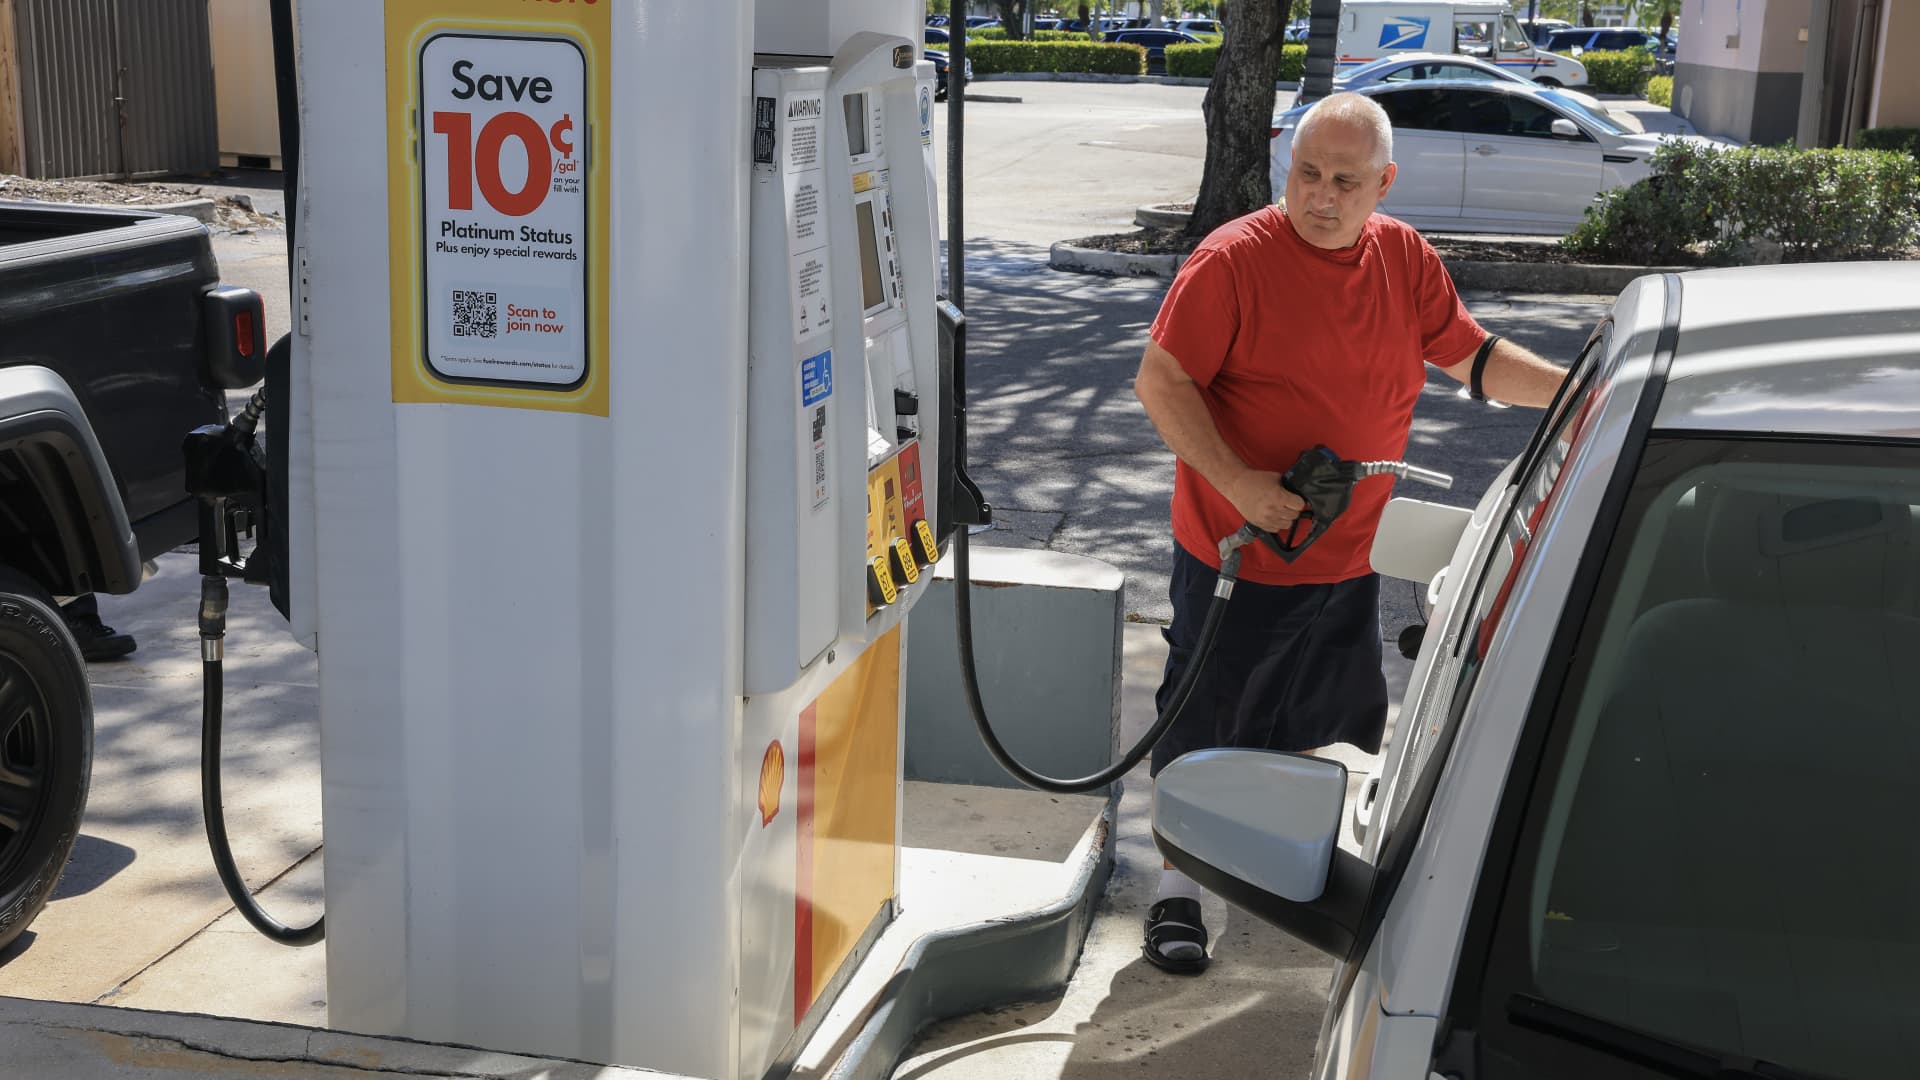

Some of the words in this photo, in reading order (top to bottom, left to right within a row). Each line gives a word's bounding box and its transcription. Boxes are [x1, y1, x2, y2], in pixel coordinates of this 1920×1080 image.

[451, 60, 553, 103] Save
[793, 98, 821, 117] WARNING
[553, 184, 562, 193] fill
[563, 185, 579, 193] with
[564, 178, 581, 186] your
[441, 219, 515, 241] Platinum
[519, 225, 573, 245] Status
[435, 241, 459, 253] Plus
[461, 243, 490, 258] enjoy
[493, 245, 530, 259] special
[532, 248, 577, 261] rewards
[507, 303, 538, 318] Scan
[542, 307, 557, 319] to
[506, 317, 531, 334] join
[534, 322, 564, 334] now
